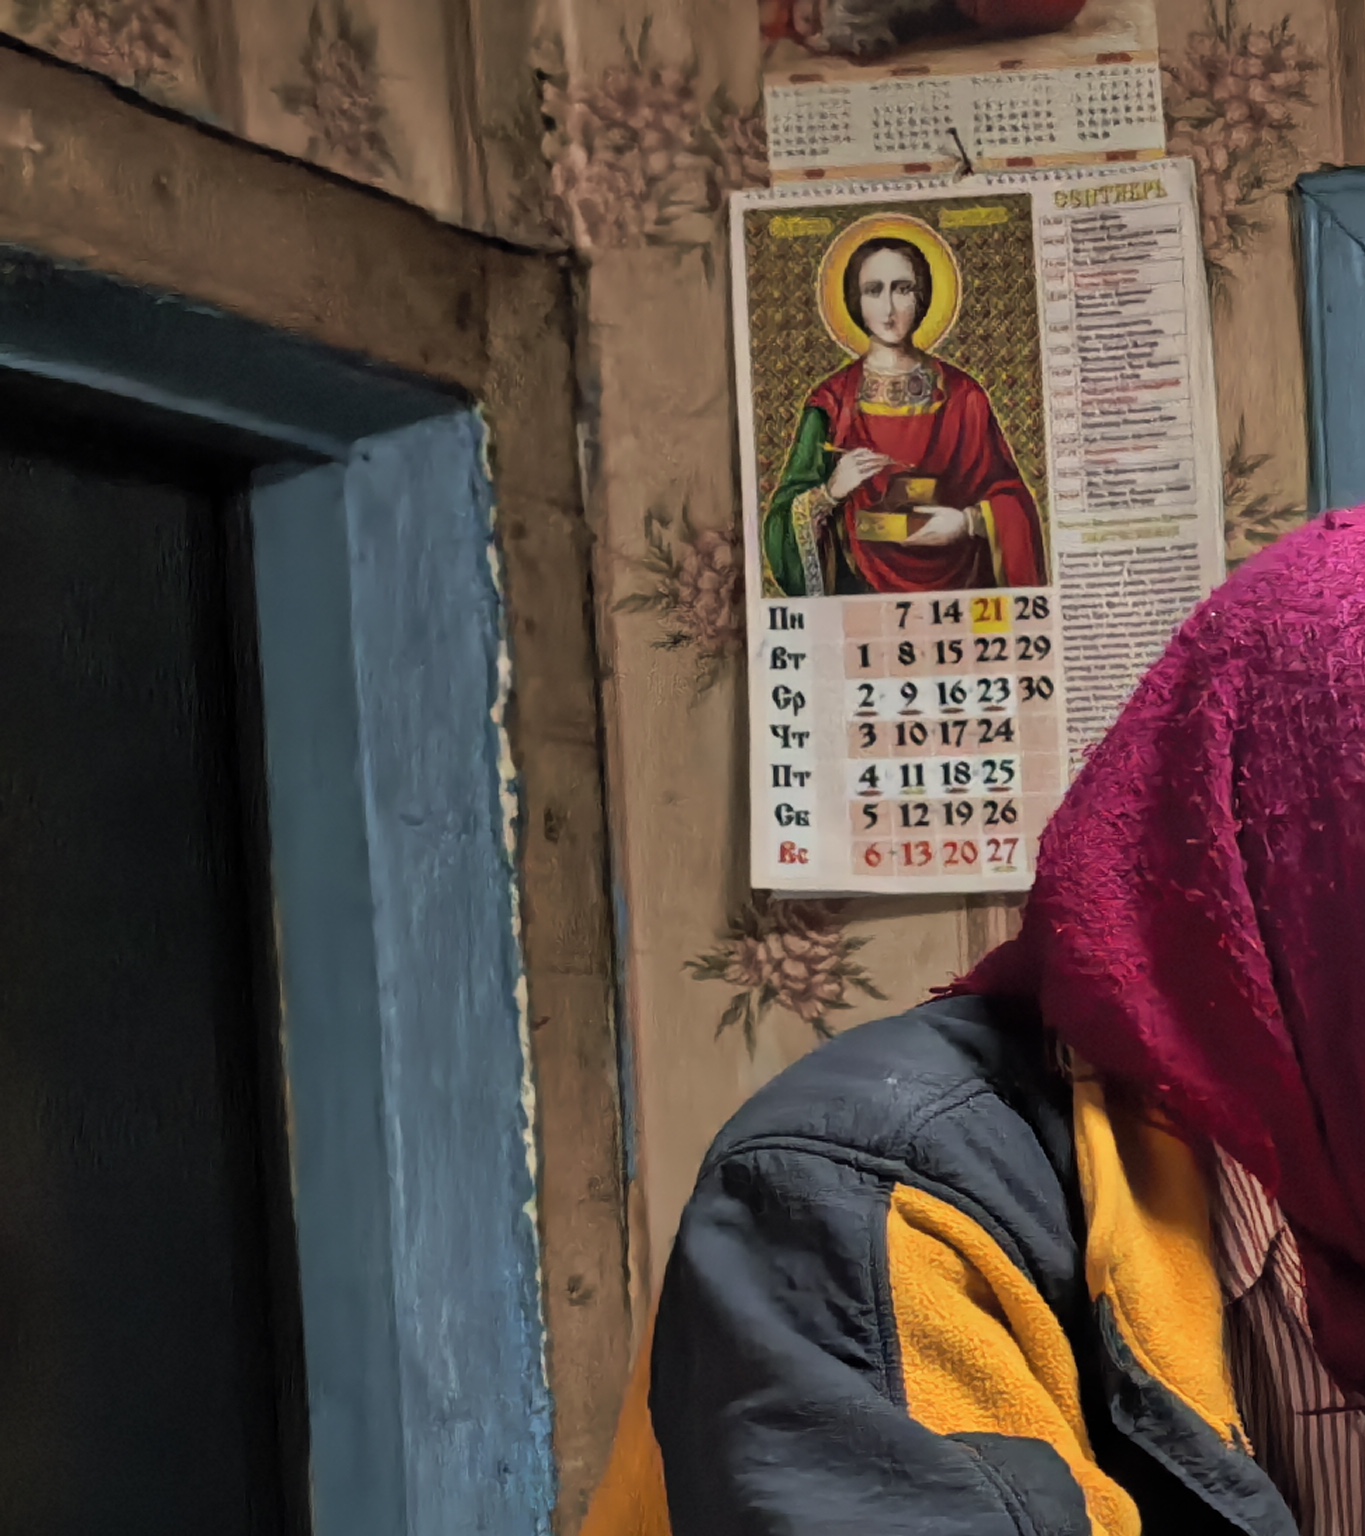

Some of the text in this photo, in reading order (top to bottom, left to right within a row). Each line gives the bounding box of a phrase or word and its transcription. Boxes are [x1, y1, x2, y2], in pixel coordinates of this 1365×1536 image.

[768, 596, 1050, 630] Пн 7 14 21 28
[769, 635, 1051, 669] Вт 1 8 15 22 29
[857, 683, 875, 707] 2
[900, 681, 918, 705] 9
[938, 680, 967, 705] 16
[977, 677, 1010, 702] 23
[1018, 676, 1054, 701] 30
[769, 718, 1014, 748] Чт 3 10 17 24
[771, 759, 1014, 788] Пт 4 11 18 25
[863, 803, 879, 829] 5
[898, 802, 930, 827] 12
[942, 801, 974, 826] 19
[982, 799, 1018, 824] 26
[864, 843, 882, 867] 6
[901, 841, 932, 866] 13
[943, 841, 979, 867] 20
[987, 837, 1019, 864] 27
